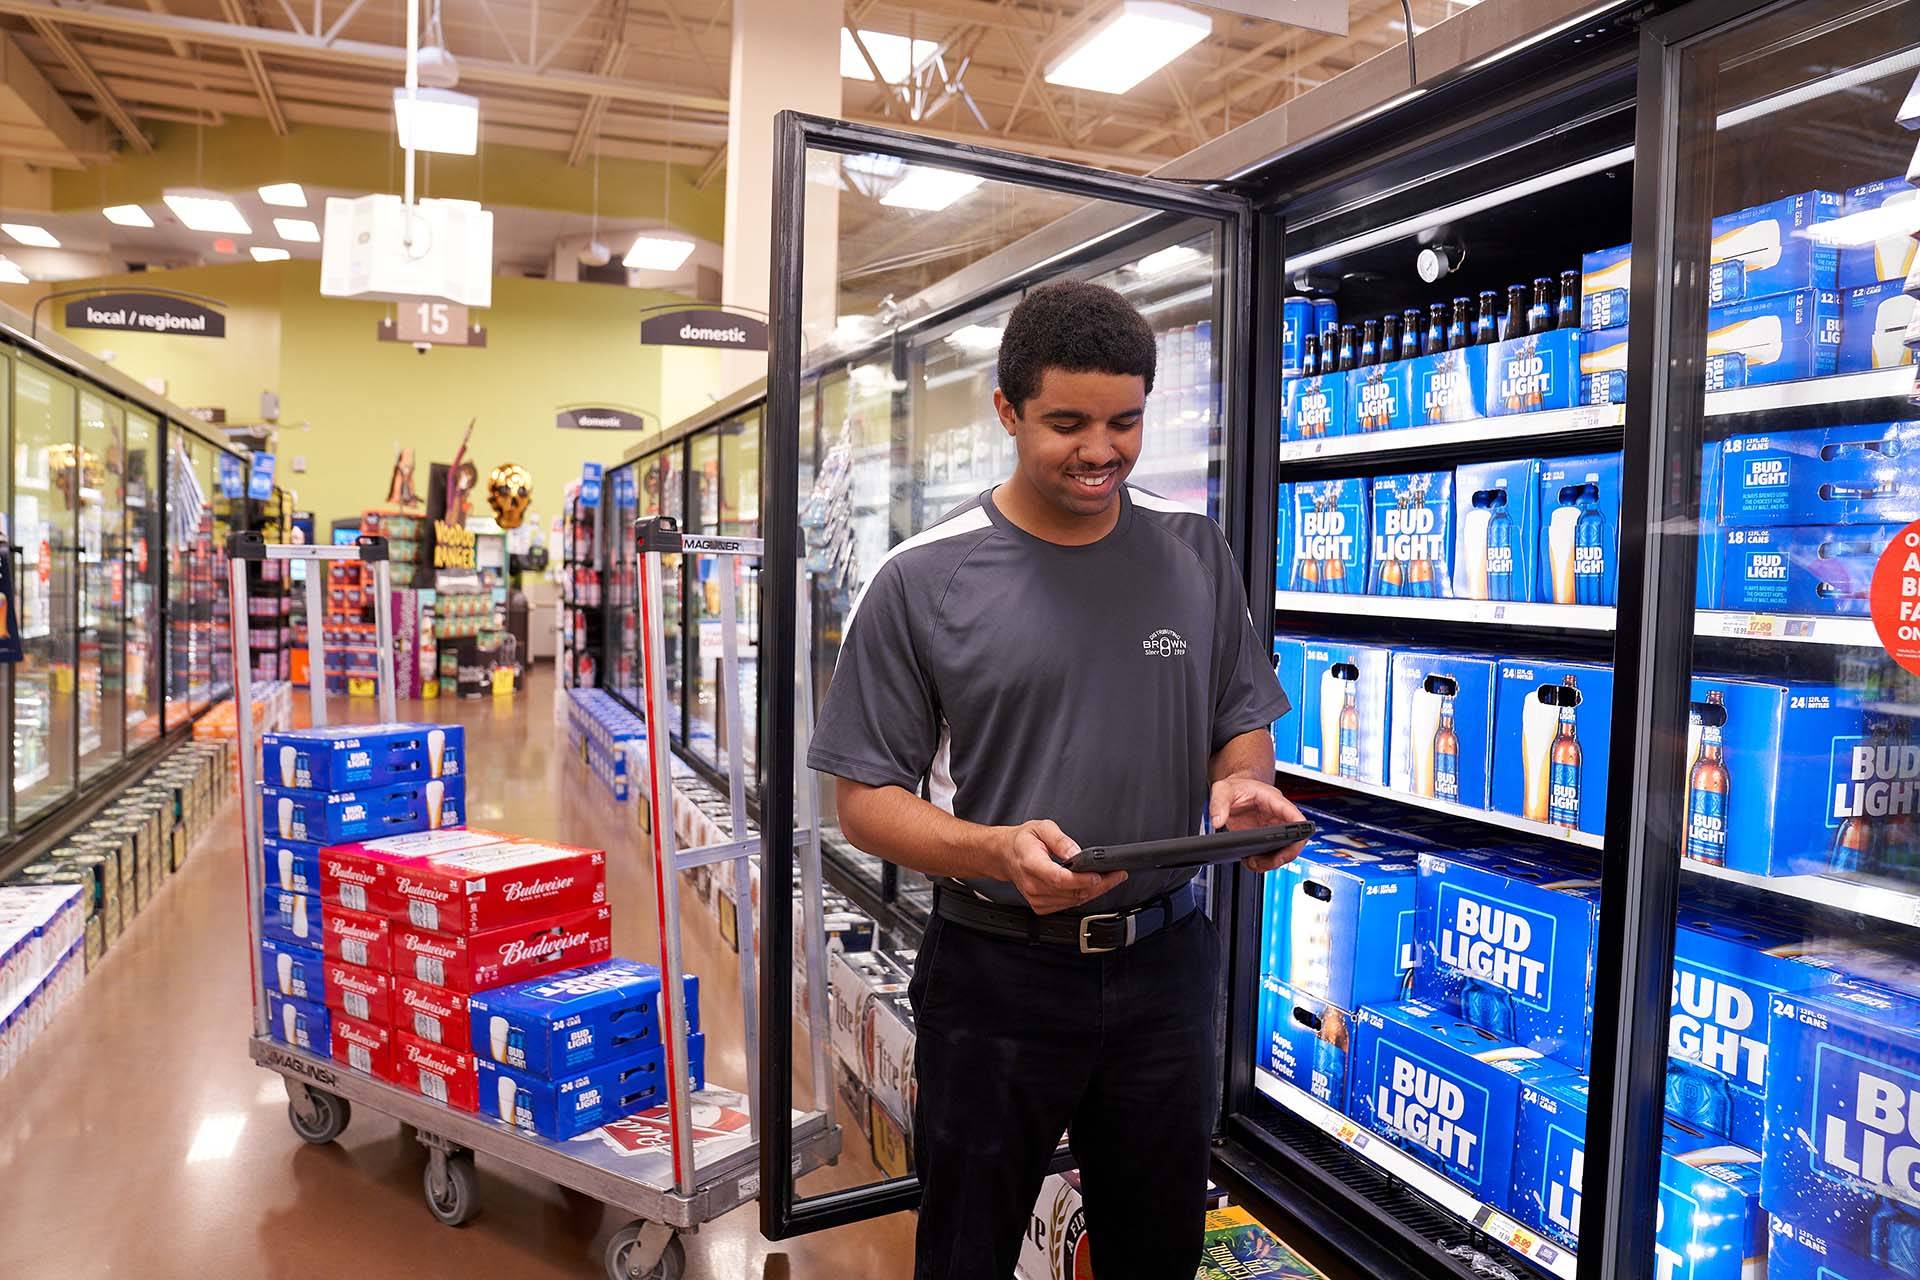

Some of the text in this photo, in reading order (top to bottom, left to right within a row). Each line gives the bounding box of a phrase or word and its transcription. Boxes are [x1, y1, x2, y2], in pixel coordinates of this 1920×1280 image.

[1820, 194, 1833, 205] 12
[1854, 187, 1866, 197] 12
[1711, 267, 1723, 302] BUD
[1852, 287, 1864, 297] 12
[1820, 293, 1833, 304] 12
[1602, 294, 1611, 325] BUD
[87, 307, 206, 331] local / regional
[416, 303, 449, 335] 15
[680, 324, 747, 343] domestic
[1508, 357, 1543, 379] BUD
[1362, 382, 1389, 401] BUD
[1502, 373, 1550, 397] LIGHT
[1302, 394, 1327, 411] BUD
[1358, 397, 1395, 418] LIGHT
[579, 416, 621, 429] domestic
[1297, 407, 1332, 426] LIGHT
[1724, 439, 1742, 453] 18
[1746, 443, 1769, 451] CANS
[1752, 460, 1782, 474] BUD
[1746, 472, 1787, 486] LIGHT
[1304, 511, 1345, 536] BUD
[1385, 508, 1434, 535] BUD
[1728, 531, 1744, 544] 18
[1748, 536, 1769, 544] CANS
[1296, 535, 1352, 561] LIGHT
[1376, 534, 1444, 560] LIGHT
[1488, 547, 1511, 560] BUD
[1576, 547, 1602, 559] BUD
[1753, 554, 1782, 567] BUD
[1747, 566, 1786, 578] LIGHT
[1749, 621, 1772, 632] 17.99
[1143, 637, 1187, 655] BROWN
[1503, 667, 1514, 679] 24
[1791, 696, 1806, 709] 24
[1852, 745, 1920, 780] BUD
[1437, 771, 1456, 783] BUD
[1435, 782, 1458, 794] LIGHT
[1553, 784, 1576, 797] BUD
[1550, 794, 1579, 811] LIGHT
[1693, 813, 1722, 830] BUD
[1689, 825, 1725, 844] LIGHT
[327, 860, 376, 884] Budweiser
[396, 876, 448, 901] Budweiser
[503, 876, 575, 901] Budweiser
[1366, 885, 1378, 895] 24
[332, 917, 379, 941] Budweiser
[1456, 897, 1532, 952] BUD
[404, 933, 456, 958] Budweiser
[498, 931, 590, 966] Budweiser
[1441, 928, 1545, 998] LIGHT
[332, 968, 378, 995] Budweiser
[402, 988, 451, 1017] Budweiser
[1773, 999, 1795, 1020] 24
[553, 1020, 565, 1031] 24
[1800, 1014, 1828, 1030] CANS
[338, 1022, 380, 1049] Budweiser
[567, 1035, 593, 1049] LIGHT
[570, 1029, 590, 1040] BUD
[1272, 1031, 1293, 1051] Hops.
[508, 1046, 525, 1059] BUD
[1272, 1045, 1297, 1067] Barley.
[1669, 1013, 1768, 1086] GHT
[406, 1044, 457, 1076] Budweiser
[1271, 1057, 1295, 1079] Water.
[561, 1081, 573, 1093] 24
[579, 1090, 598, 1101] BUD
[1391, 1055, 1465, 1121] BUD
[1523, 1087, 1538, 1104] 24
[576, 1096, 601, 1110] LIGHT
[516, 1107, 533, 1121] BUD
[1377, 1085, 1477, 1169] LIGHT
[1772, 1216, 1794, 1239] 24
[1066, 1240, 1074, 1254] A
[1798, 1236, 1828, 1255] CANS
